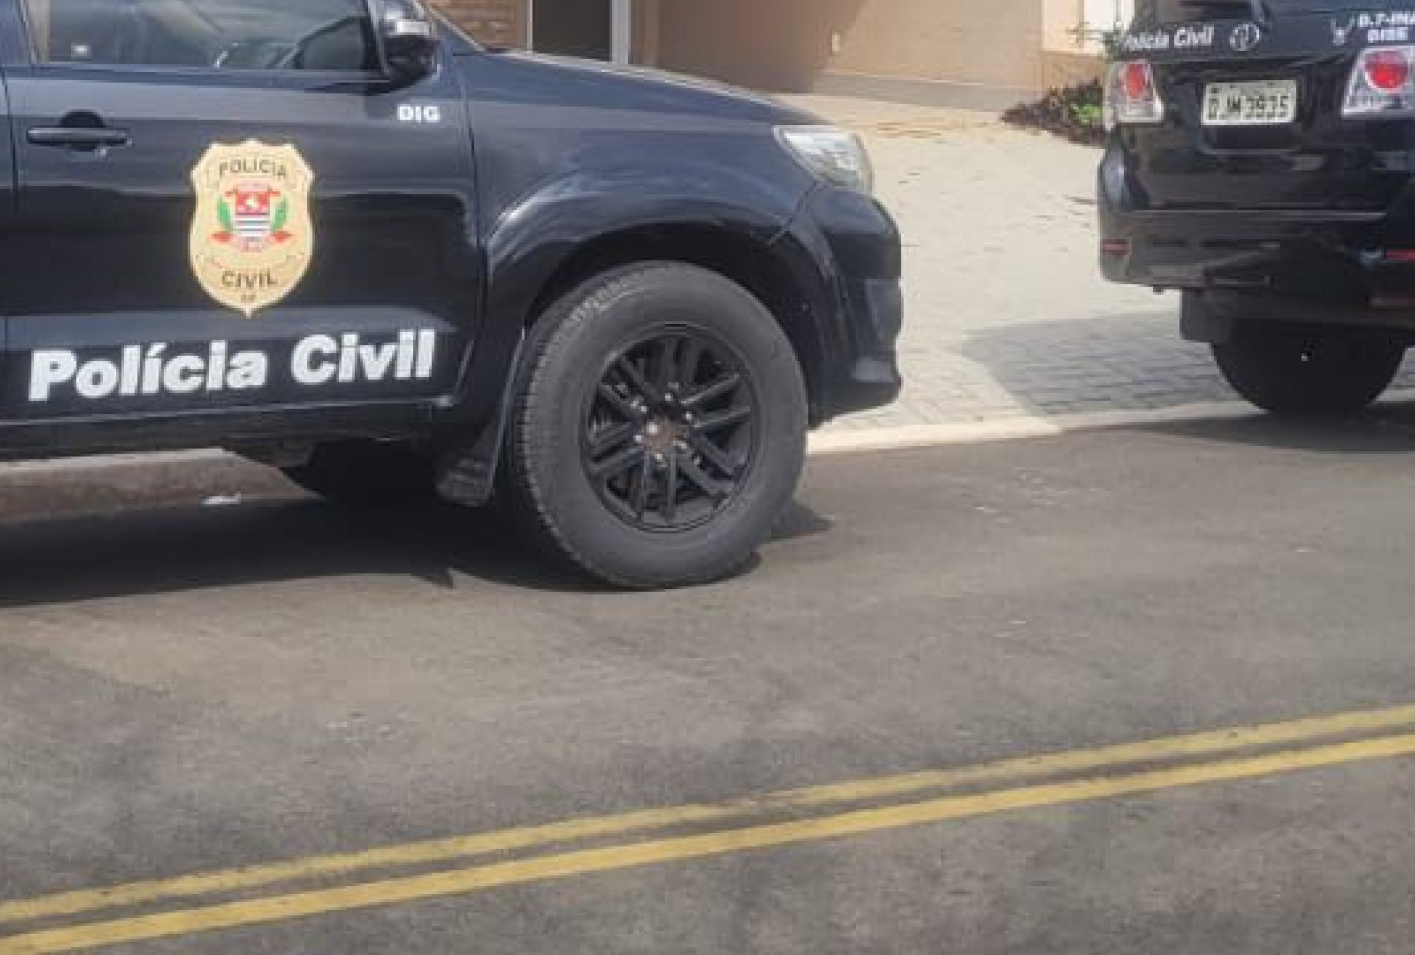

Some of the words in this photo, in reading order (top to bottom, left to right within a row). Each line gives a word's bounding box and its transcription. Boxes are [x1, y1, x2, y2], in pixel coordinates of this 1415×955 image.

[396, 104, 441, 123] DIG
[220, 269, 280, 288] CIVIL
[28, 339, 270, 402] Polícia
[289, 328, 438, 386] Civil
